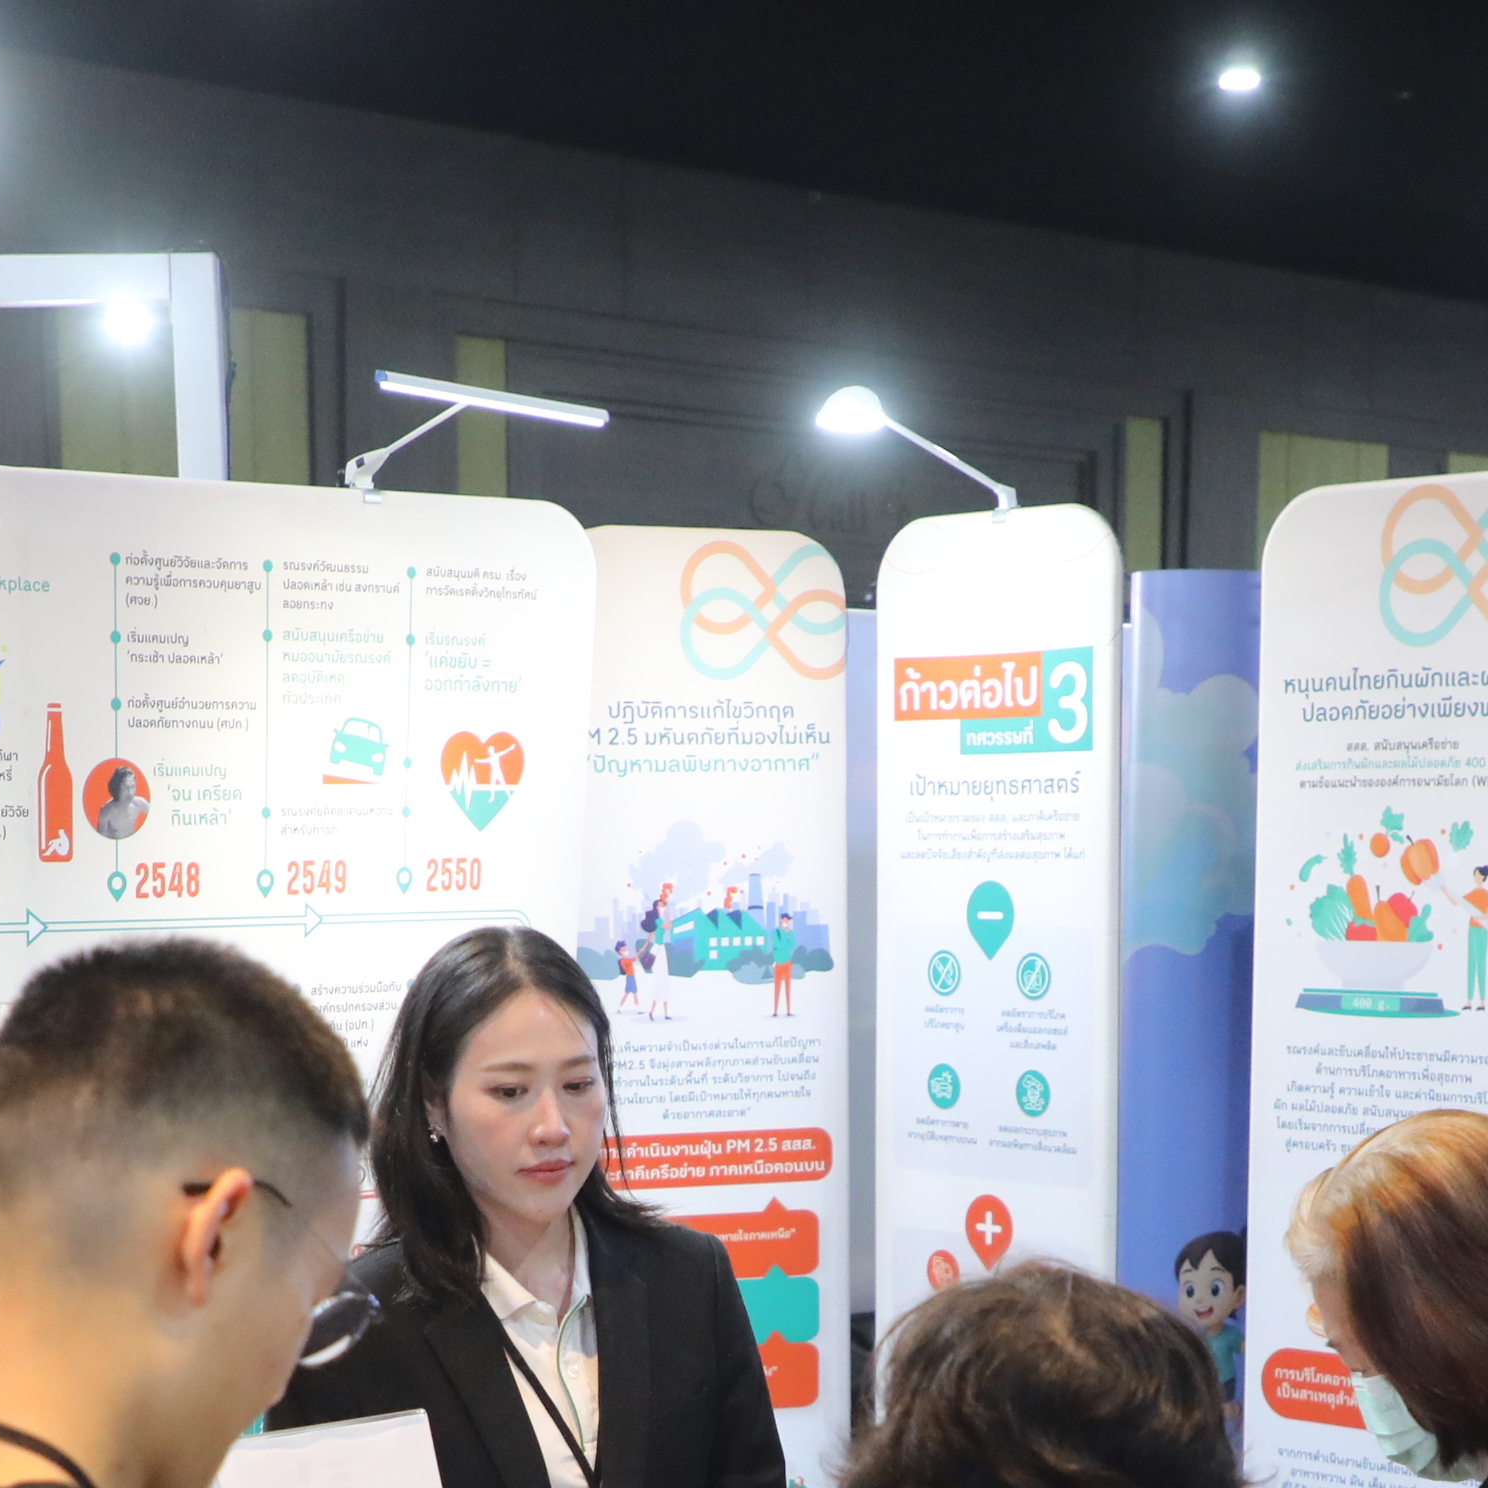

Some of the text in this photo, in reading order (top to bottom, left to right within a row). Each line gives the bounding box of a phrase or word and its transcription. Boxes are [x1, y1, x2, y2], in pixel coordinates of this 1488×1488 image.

[125, 550, 248, 571] ก่อตั้งศูนย์วิจัยและจัดการ
[283, 560, 369, 574] รณรงค์วัฒนธรรม
[125, 571, 261, 594] ความรู้เพื่อการควบคุมยาสูบ
[283, 579, 333, 592] ปลอดเหล้า
[355, 580, 400, 594] สงกรานต์
[283, 599, 334, 610] ลอยกระทง
[127, 627, 189, 648] เริ่มแคมเปญ
[127, 693, 257, 713] ก่อตั้งศูนย์อำนวยการความ
[607, 699, 795, 724] ปฏิบัติการแก้ไขวิกฤต
[900, 661, 1088, 744] ก้าวต่อไป 3
[127, 716, 214, 730] ปลอดภัยทางถนน
[608, 721, 831, 746] 2.5 มหันตภัยที่มองไม่เห็น
[966, 719, 1034, 746] ทศวรรษที่
[153, 757, 227, 779] เริ่มแคมเปญ
[1465, 757, 1485, 768] 400
[196, 783, 242, 802] เครียด
[910, 771, 1081, 802] เป้าหมายยุทธศาสตร์
[135, 862, 200, 899] 2548
[287, 859, 347, 896] 2549
[426, 857, 482, 892] 2550
[726, 1137, 816, 1152] PM 2.5 สสส.
[711, 1158, 825, 1177] ภาคเหนือตอนบน
